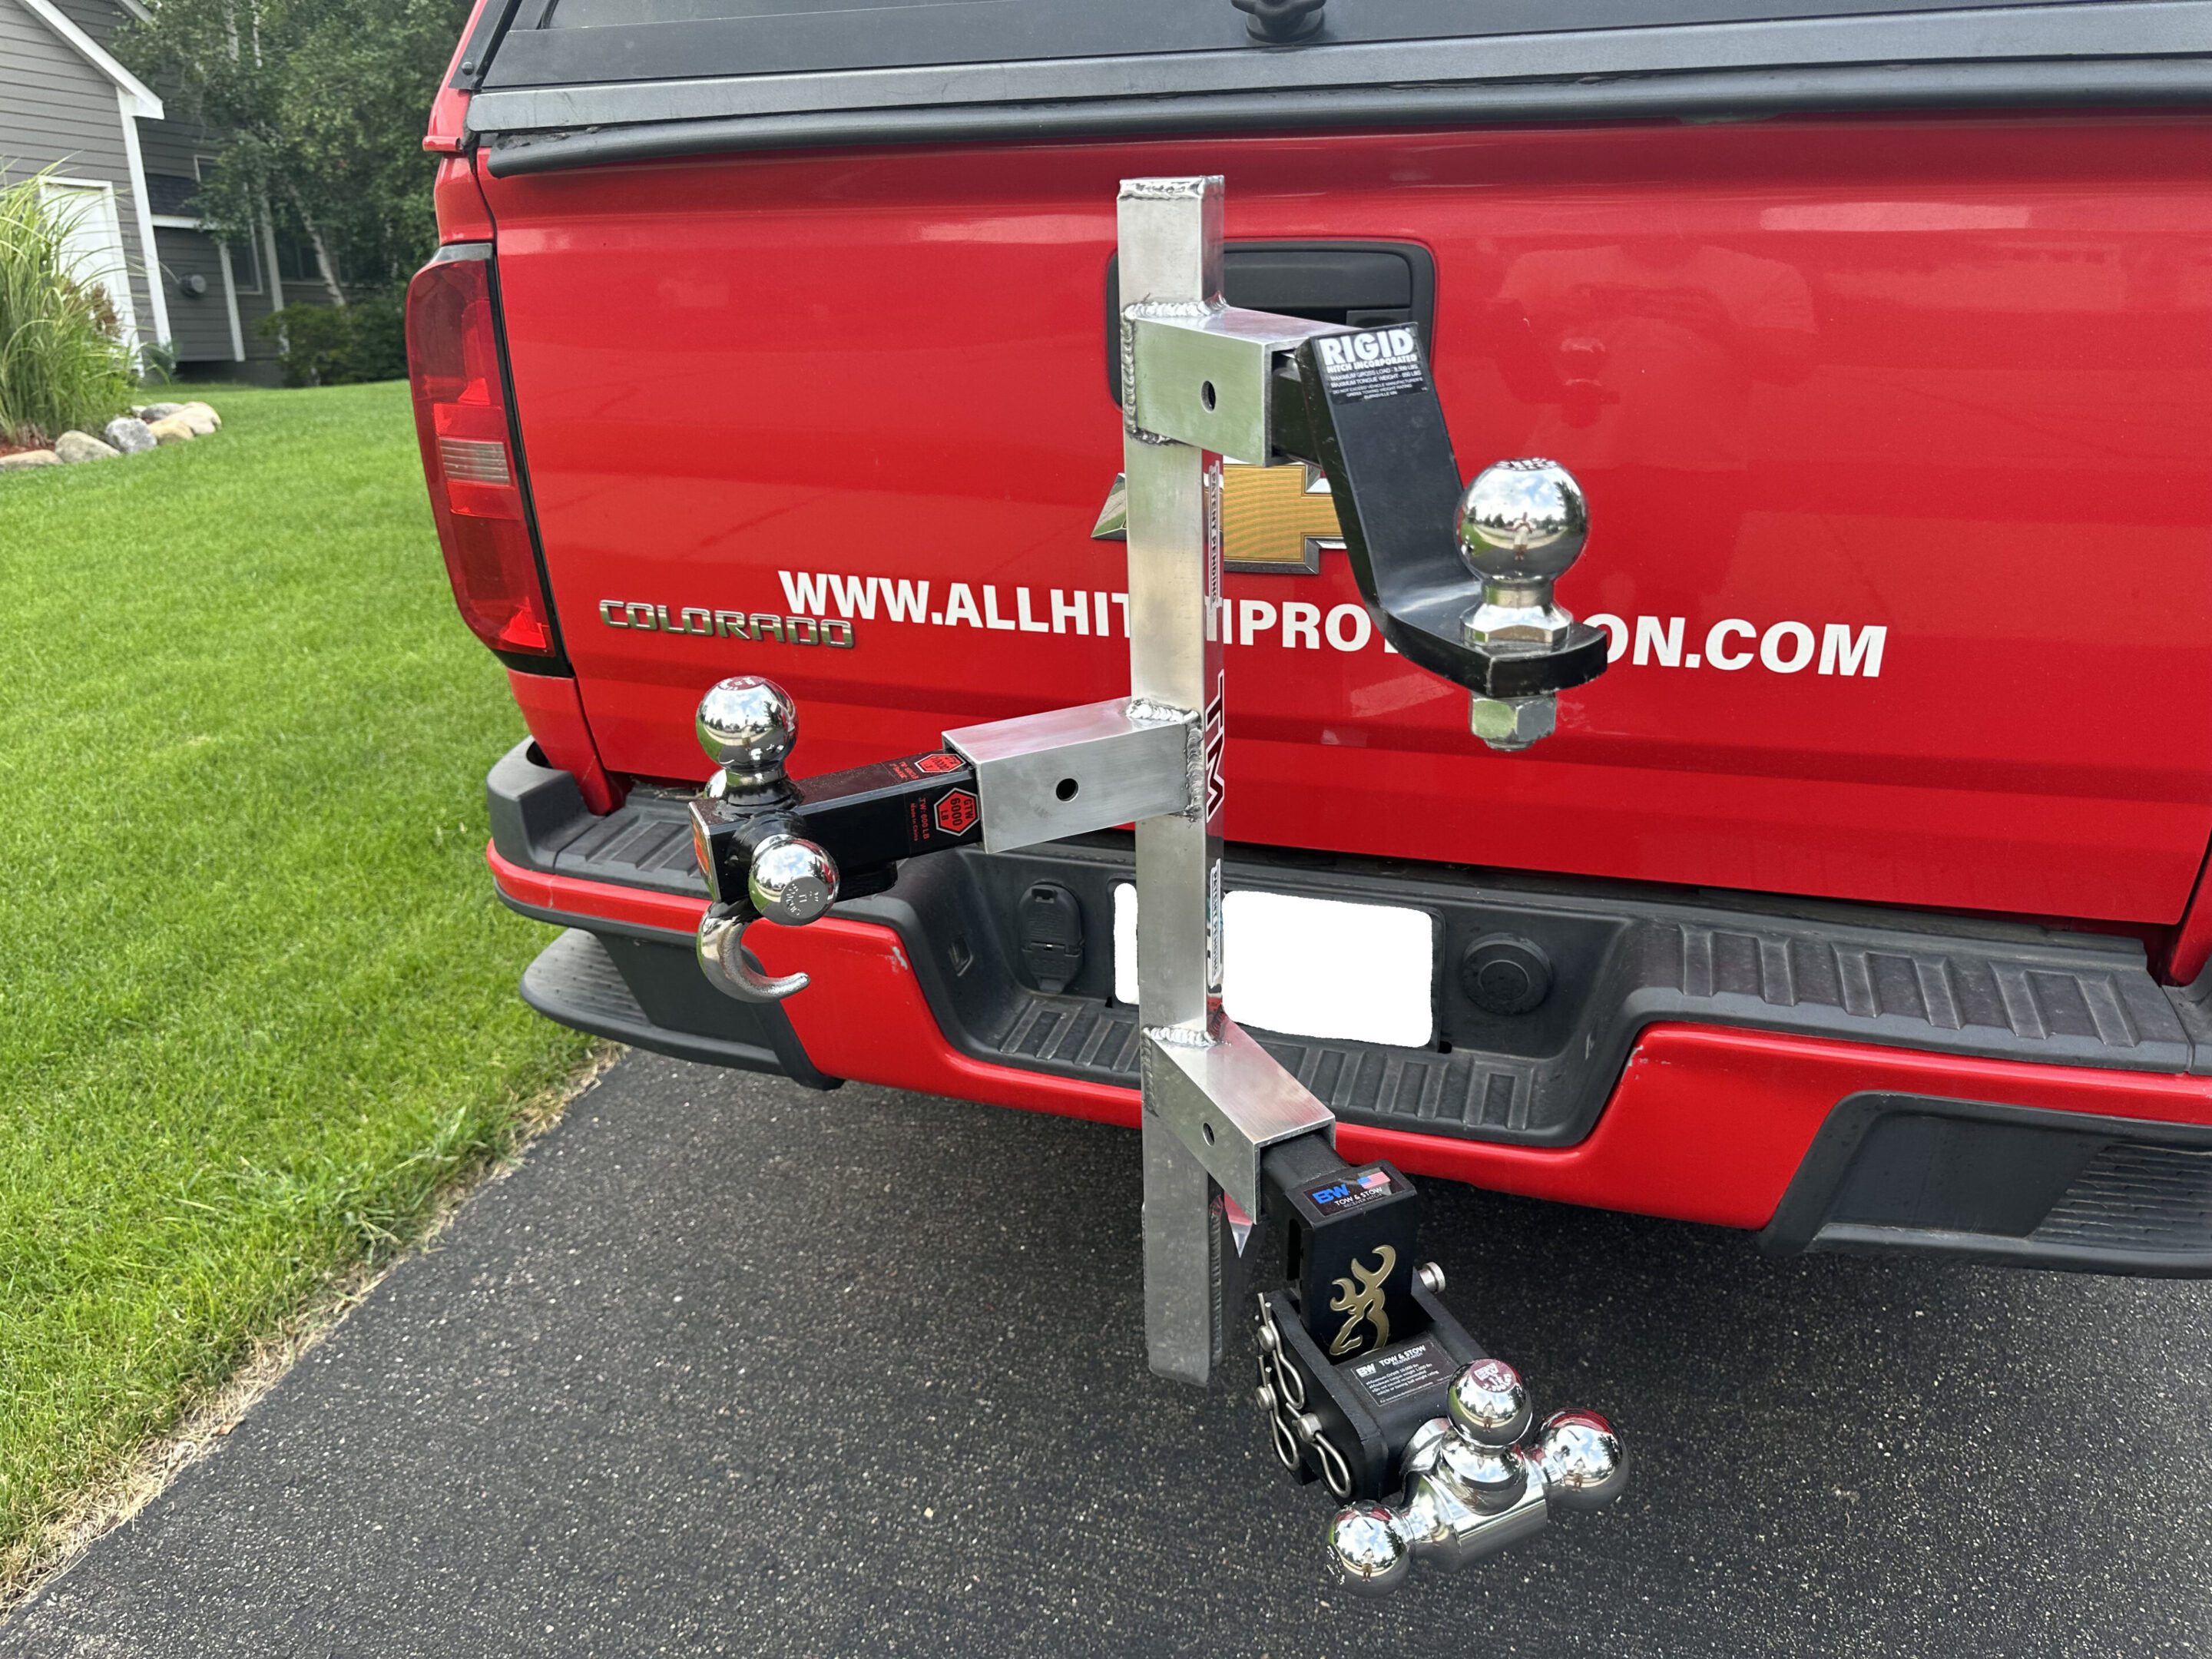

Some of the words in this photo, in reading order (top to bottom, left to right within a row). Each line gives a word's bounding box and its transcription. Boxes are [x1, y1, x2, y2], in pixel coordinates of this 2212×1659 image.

[1319, 329, 1413, 365] RIGID
[1326, 363, 1352, 373] HITCH
[1353, 354, 1417, 369] INCORPORATED
[600, 599, 855, 648] COLORADO
[941, 810, 949, 821] LB
[950, 797, 962, 826] 6000
[963, 798, 974, 820] GTW
[922, 828, 930, 840] LB
[1334, 1196, 1353, 1206] TOW
[1360, 1187, 1382, 1198] STOW
[1379, 1355, 1398, 1366] TOW
[1404, 1345, 1426, 1357] STOW
